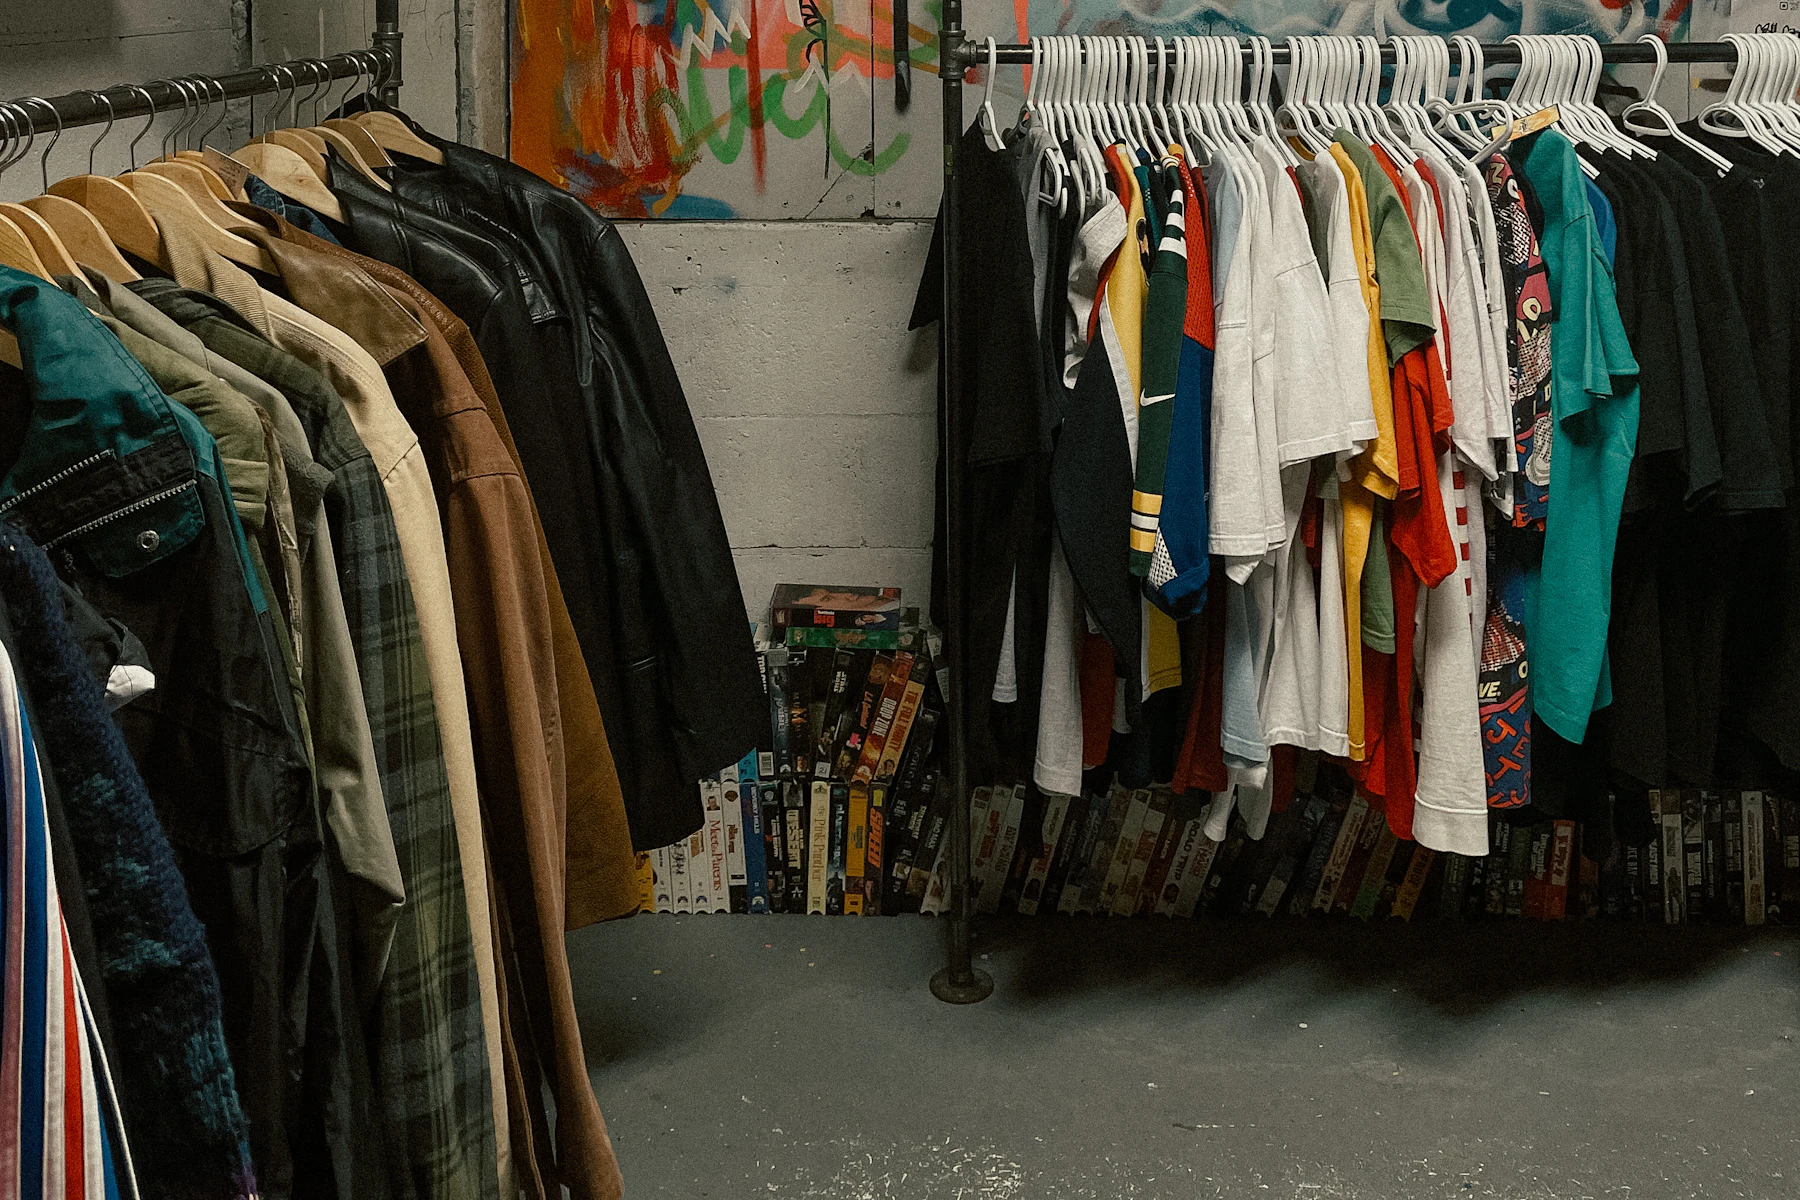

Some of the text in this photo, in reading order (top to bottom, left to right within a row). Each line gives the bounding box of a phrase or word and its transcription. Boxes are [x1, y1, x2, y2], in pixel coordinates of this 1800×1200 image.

[898, 705, 914, 722] FULL
[904, 690, 918, 705] THE
[871, 698, 897, 738] DROP ZONE
[709, 820, 722, 845] Meet
[752, 816, 761, 835] HILLS
[785, 809, 800, 869] DESERT
[812, 819, 826, 841] Pink
[867, 807, 883, 869] SPEED
[926, 816, 944, 849] MAD MAX
[811, 843, 826, 882] Panther
[1173, 820, 1200, 881] ROAD TRIP
[711, 853, 724, 891] Parents
